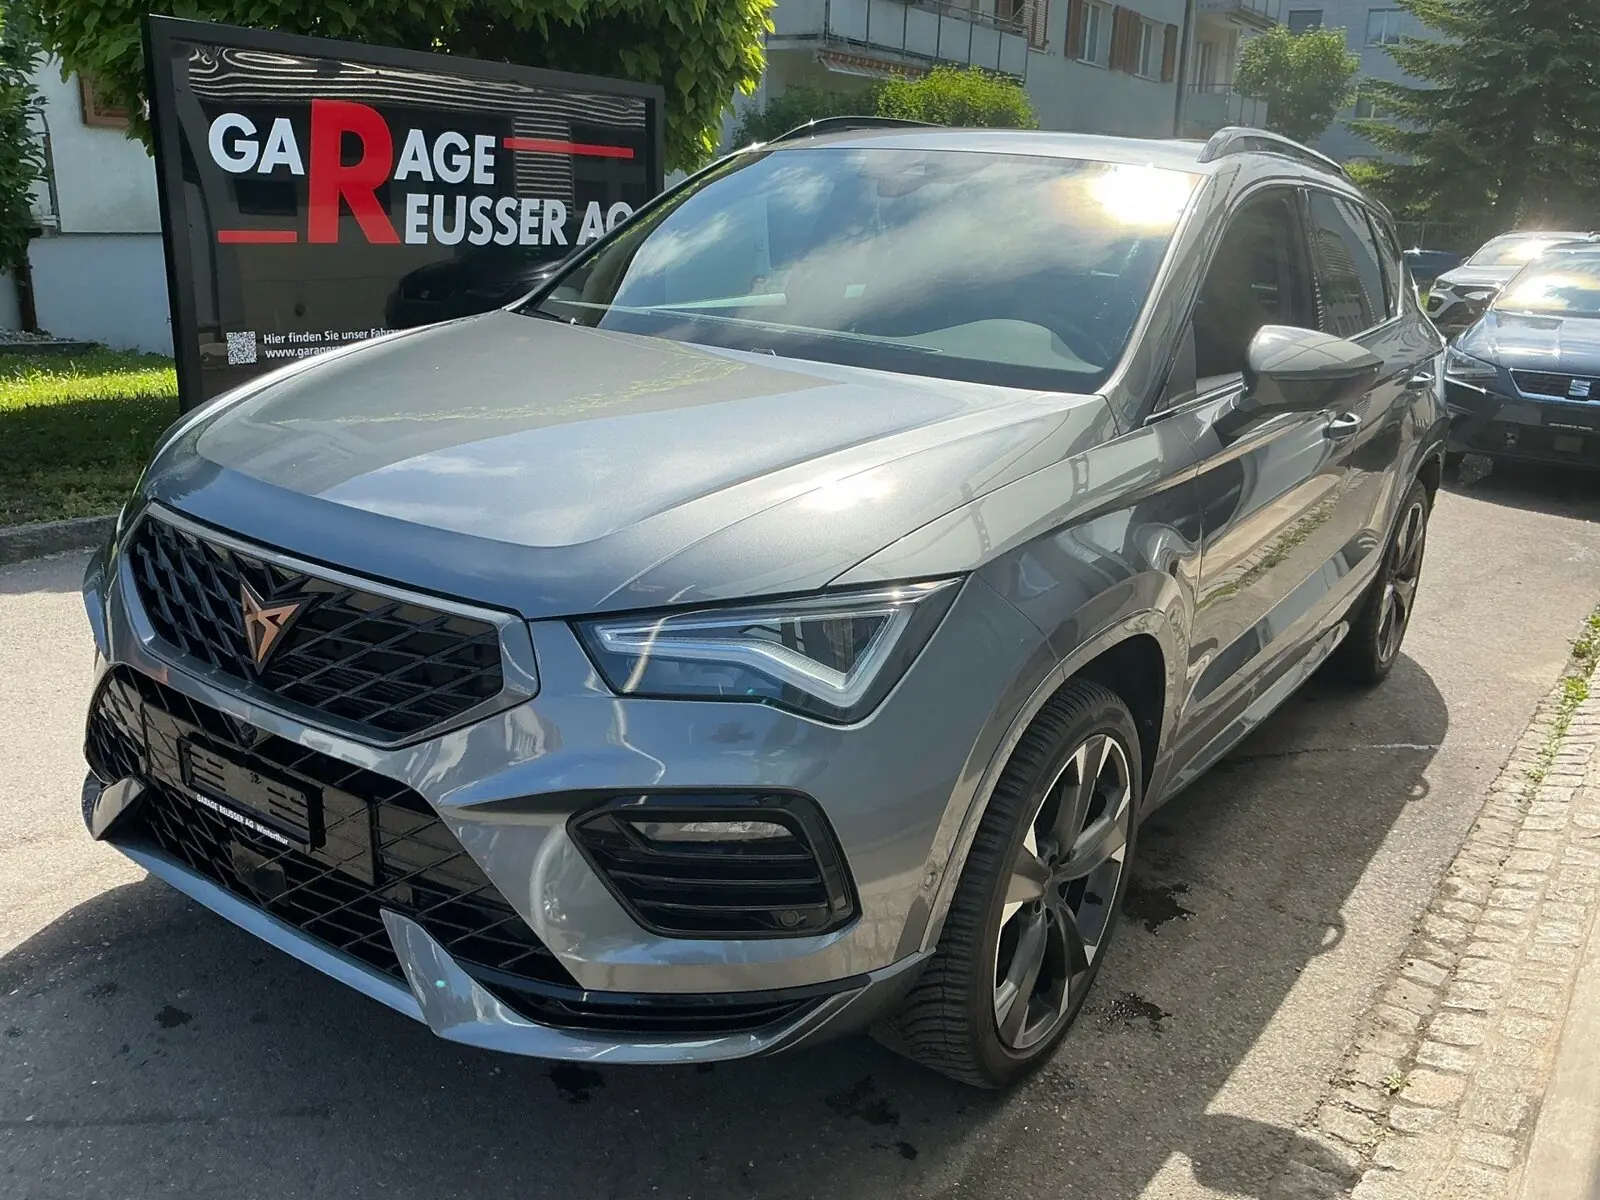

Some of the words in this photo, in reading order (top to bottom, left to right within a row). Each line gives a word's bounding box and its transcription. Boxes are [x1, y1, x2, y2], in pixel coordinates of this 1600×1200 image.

[208, 98, 496, 243] GARAGE
[263, 333, 286, 345] Hier
[288, 331, 322, 343] finden
[324, 330, 340, 341] Sie
[341, 330, 369, 340] unser
[196, 794, 219, 811] GARAGE
[245, 818, 255, 829] AG
[256, 823, 289, 845] Winterthur
